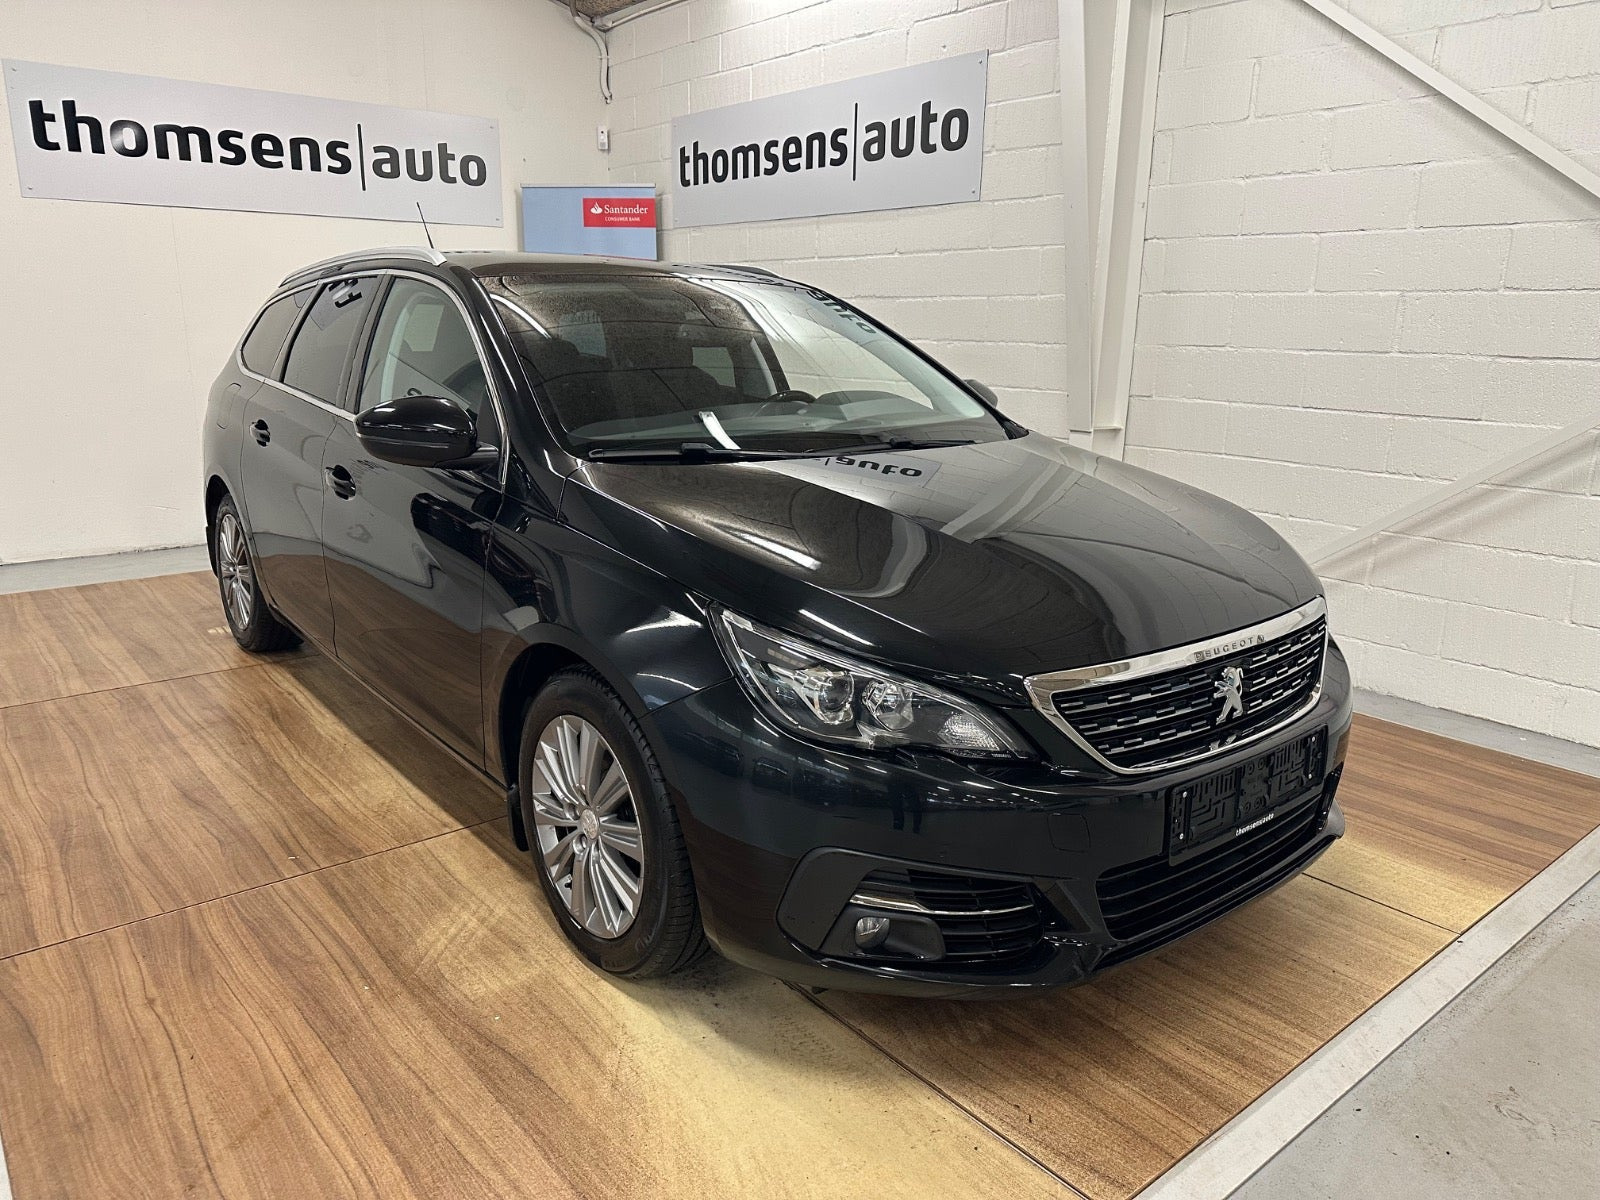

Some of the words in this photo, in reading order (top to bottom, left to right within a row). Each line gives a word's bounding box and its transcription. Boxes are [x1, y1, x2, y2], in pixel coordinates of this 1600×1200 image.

[28, 99, 352, 175] thomsens
[371, 142, 488, 187] auto
[679, 127, 848, 188] thomsens
[862, 100, 969, 162] auto
[604, 204, 648, 214] Santander
[1194, 636, 1254, 662] PEUGEOT
